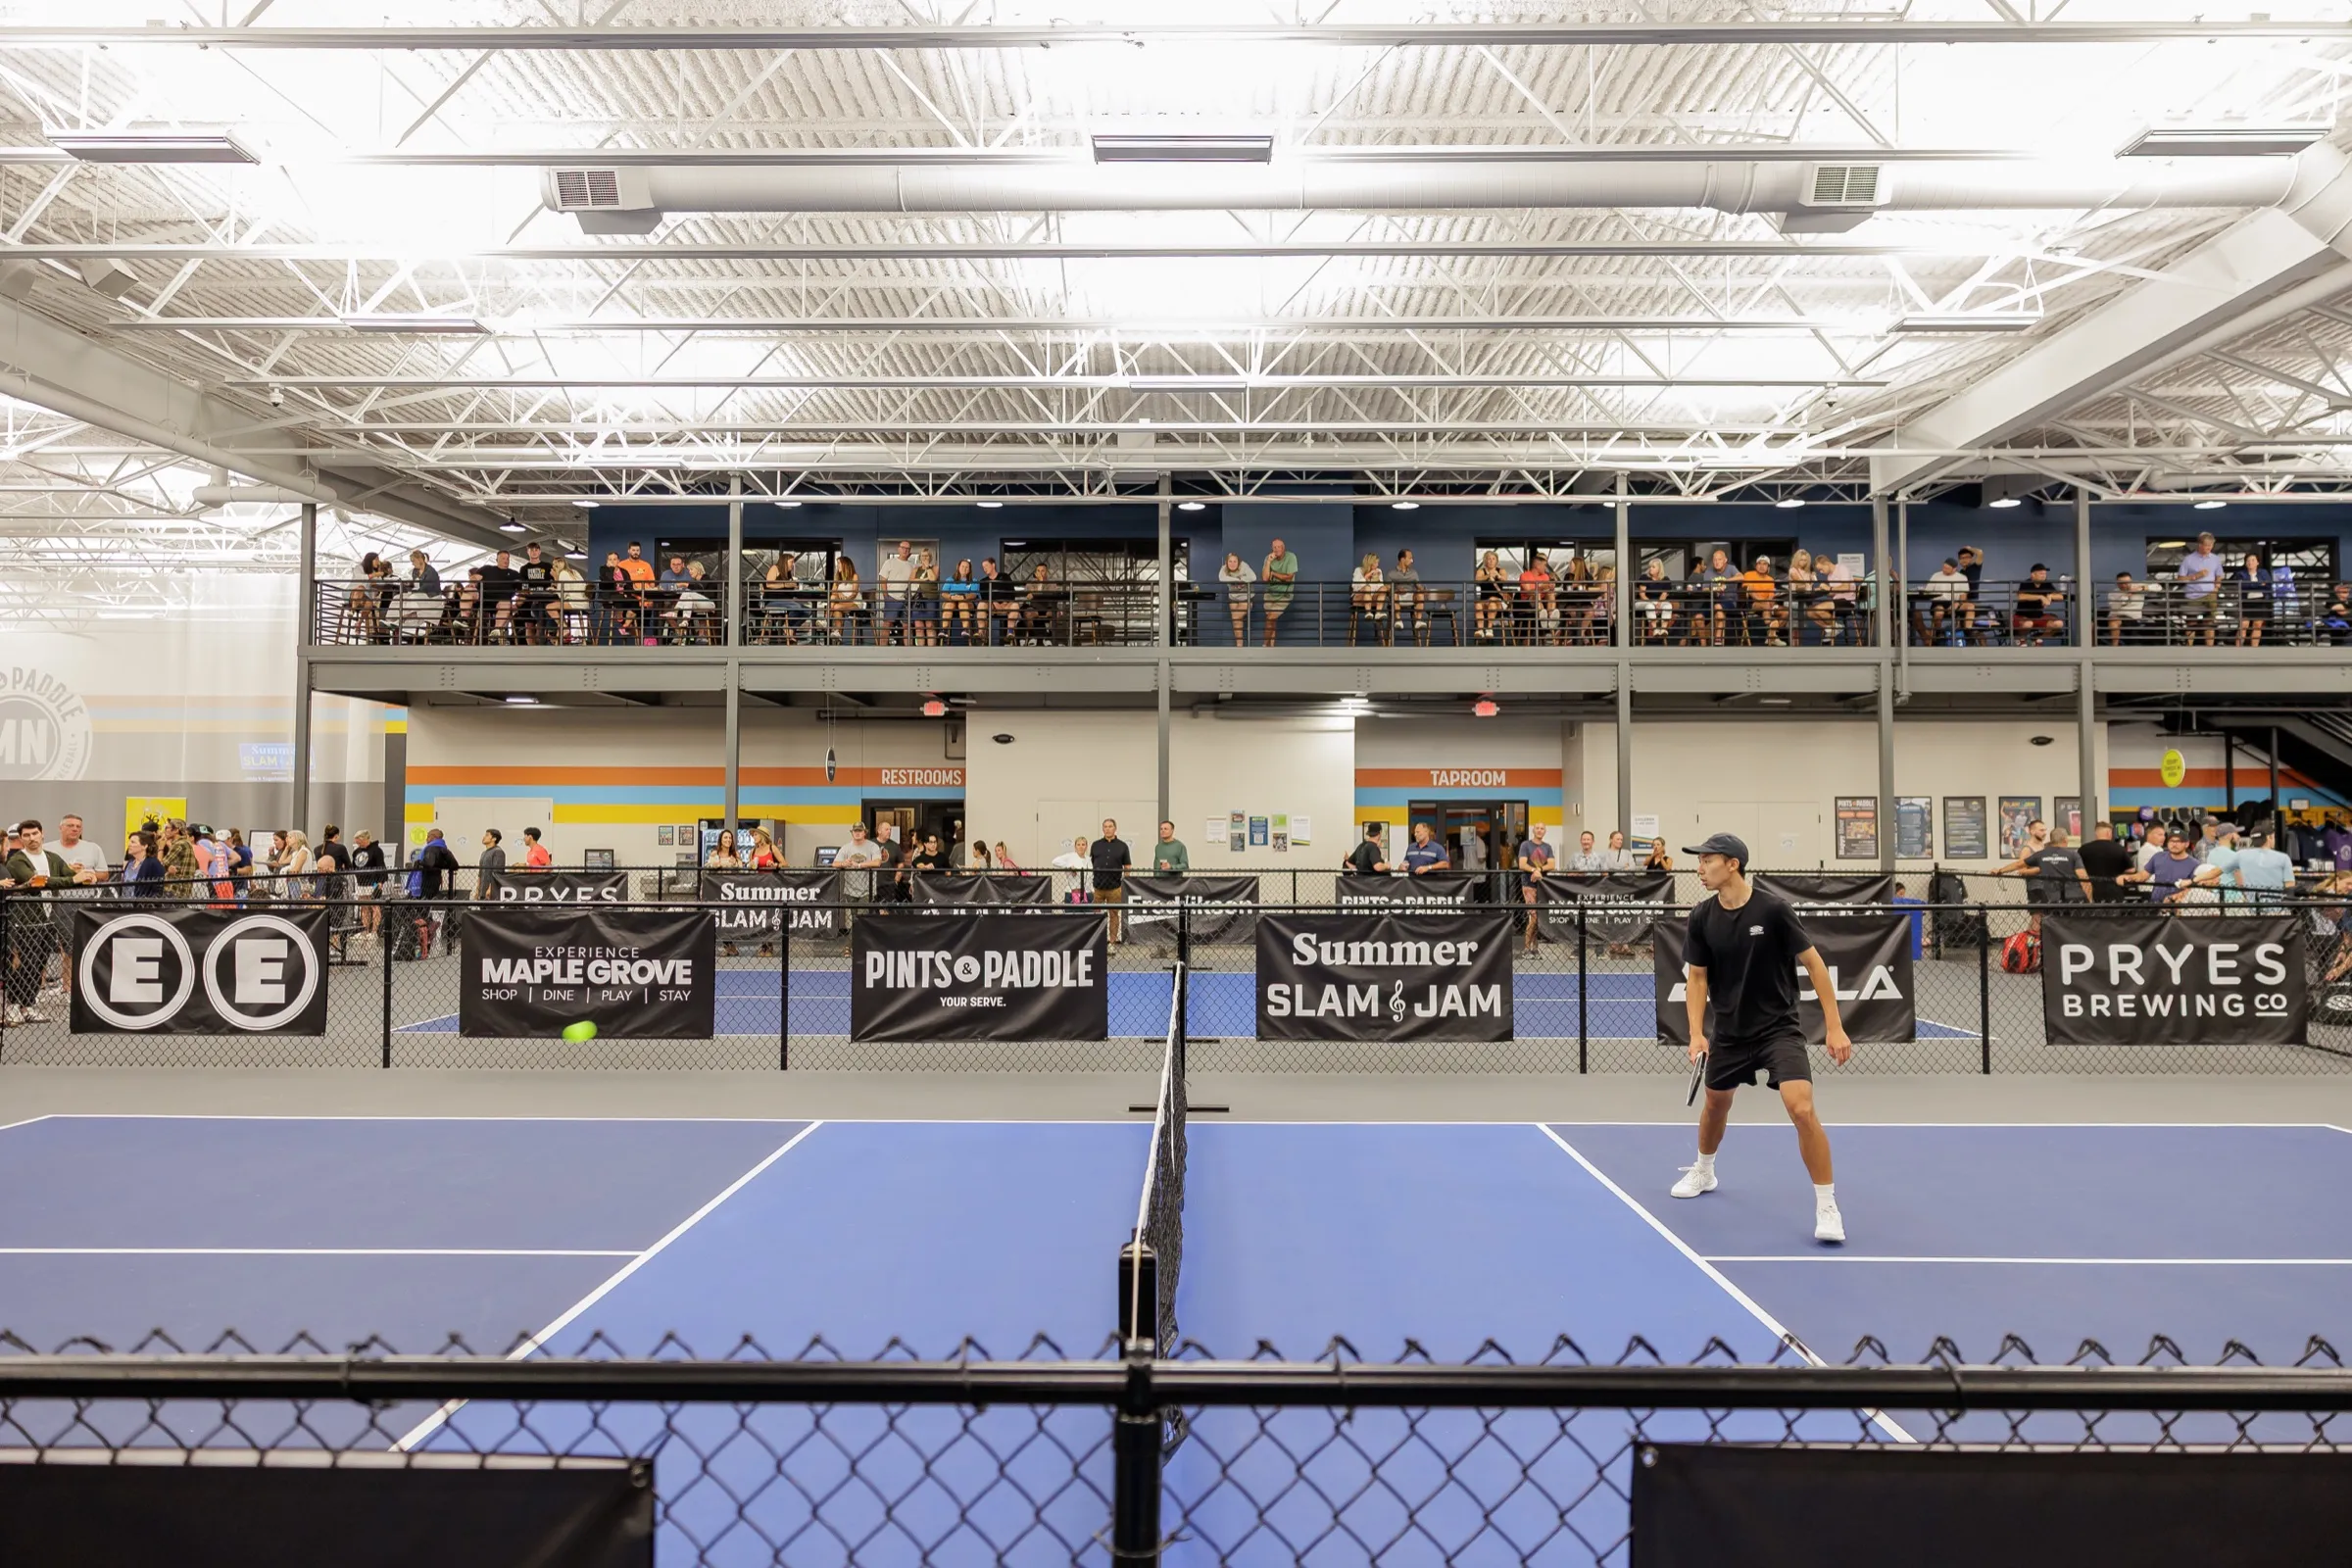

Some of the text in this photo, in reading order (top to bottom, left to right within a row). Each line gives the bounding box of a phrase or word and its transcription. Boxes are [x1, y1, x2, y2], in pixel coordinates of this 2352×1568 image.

[12, 666, 84, 723] PADDLE
[882, 769, 961, 785] RESTROOMS
[1431, 770, 1505, 786] TAPROOM
[720, 882, 821, 901] Summer
[535, 946, 639, 958] EXPERIENCE
[1292, 933, 1479, 965] Summer
[110, 938, 288, 1004] E E
[482, 958, 692, 985] MAPLE GROVE
[865, 951, 953, 989] PINTS
[984, 950, 1094, 988] PADDLE
[2060, 943, 2286, 986] PRYES
[482, 989, 692, 1002] SHOP DINE PLAY STAY
[940, 997, 1006, 1007] YOUR SERVE.
[1267, 983, 1501, 1017] SLAM JAM
[2063, 993, 2287, 1017] BREWING CO
